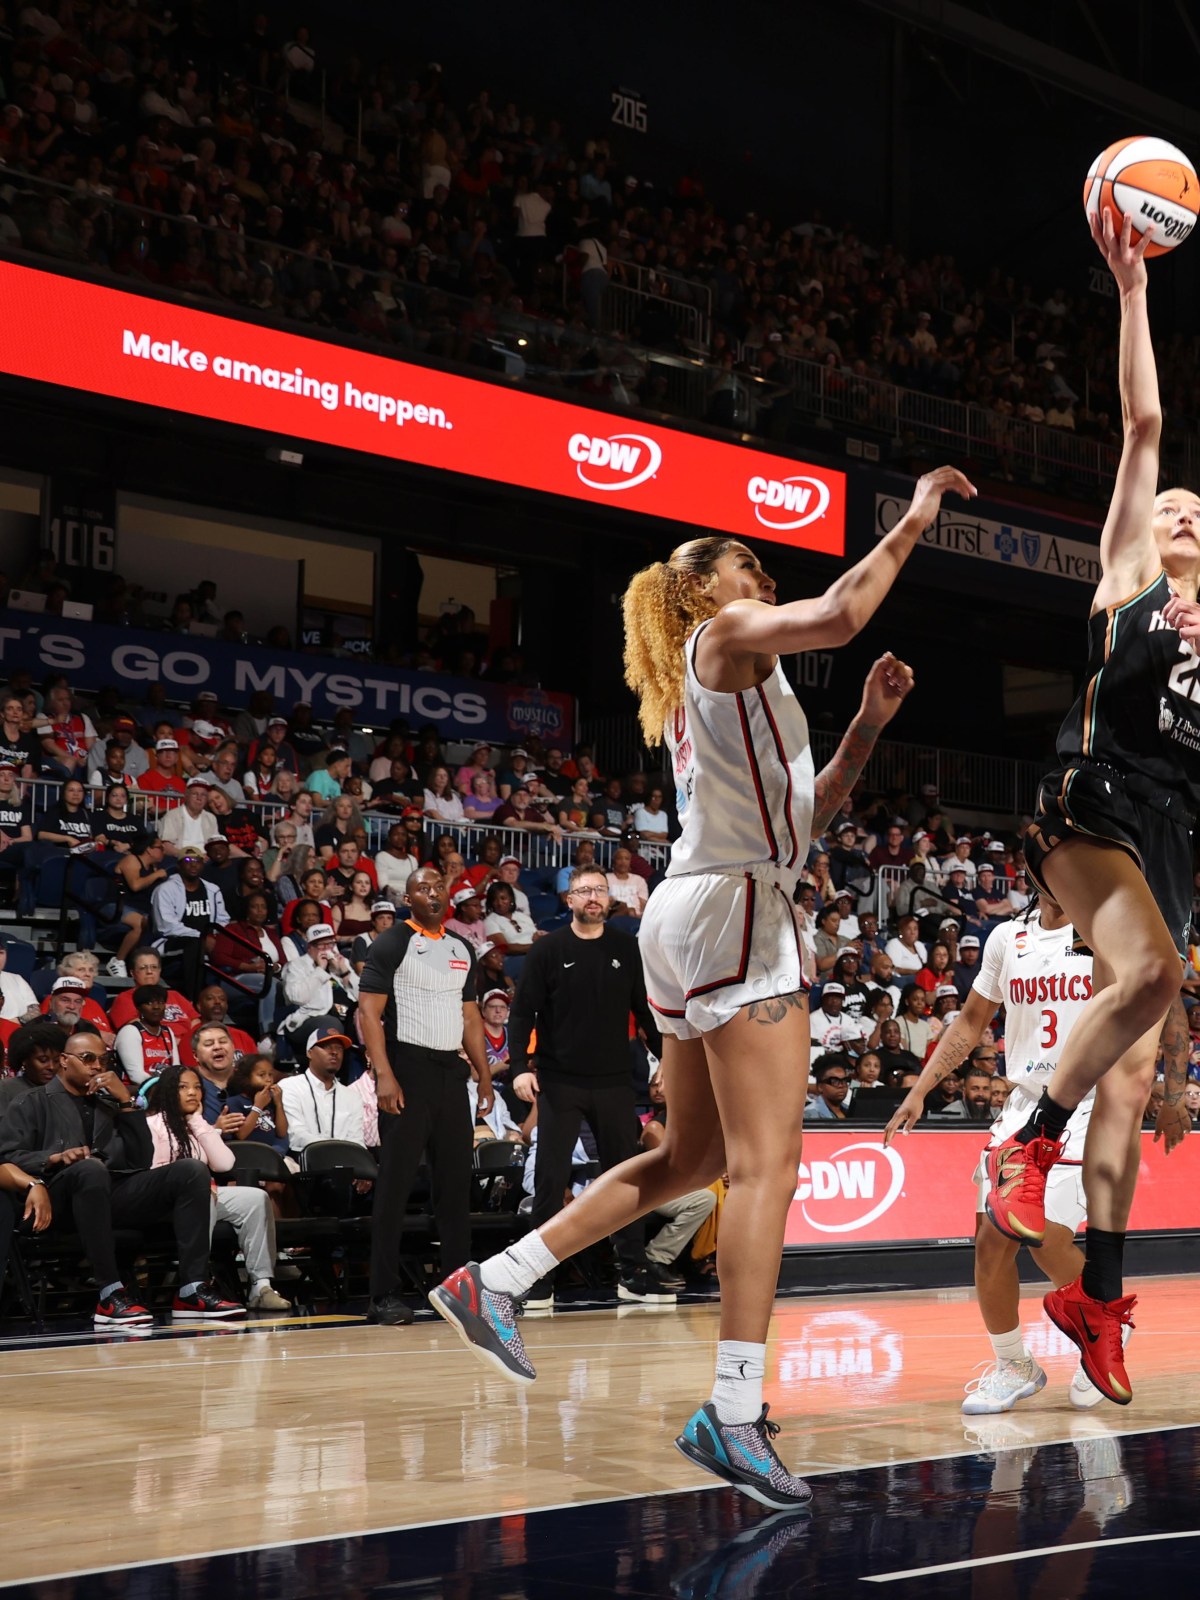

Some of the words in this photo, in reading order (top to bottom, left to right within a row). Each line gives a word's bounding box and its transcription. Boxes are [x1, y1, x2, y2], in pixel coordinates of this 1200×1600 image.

[611, 92, 647, 133] 205
[122, 330, 208, 372] Make
[212, 356, 339, 410] amazing
[344, 382, 453, 430] happen.
[568, 433, 642, 474] CDW
[747, 476, 812, 514] CDW
[50, 517, 115, 572] 106
[1044, 537, 1101, 581] Aren
[111, 644, 212, 686] GO
[234, 659, 488, 725] MYSTICS
[795, 650, 834, 689] 107
[1041, 1009, 1058, 1049] 3
